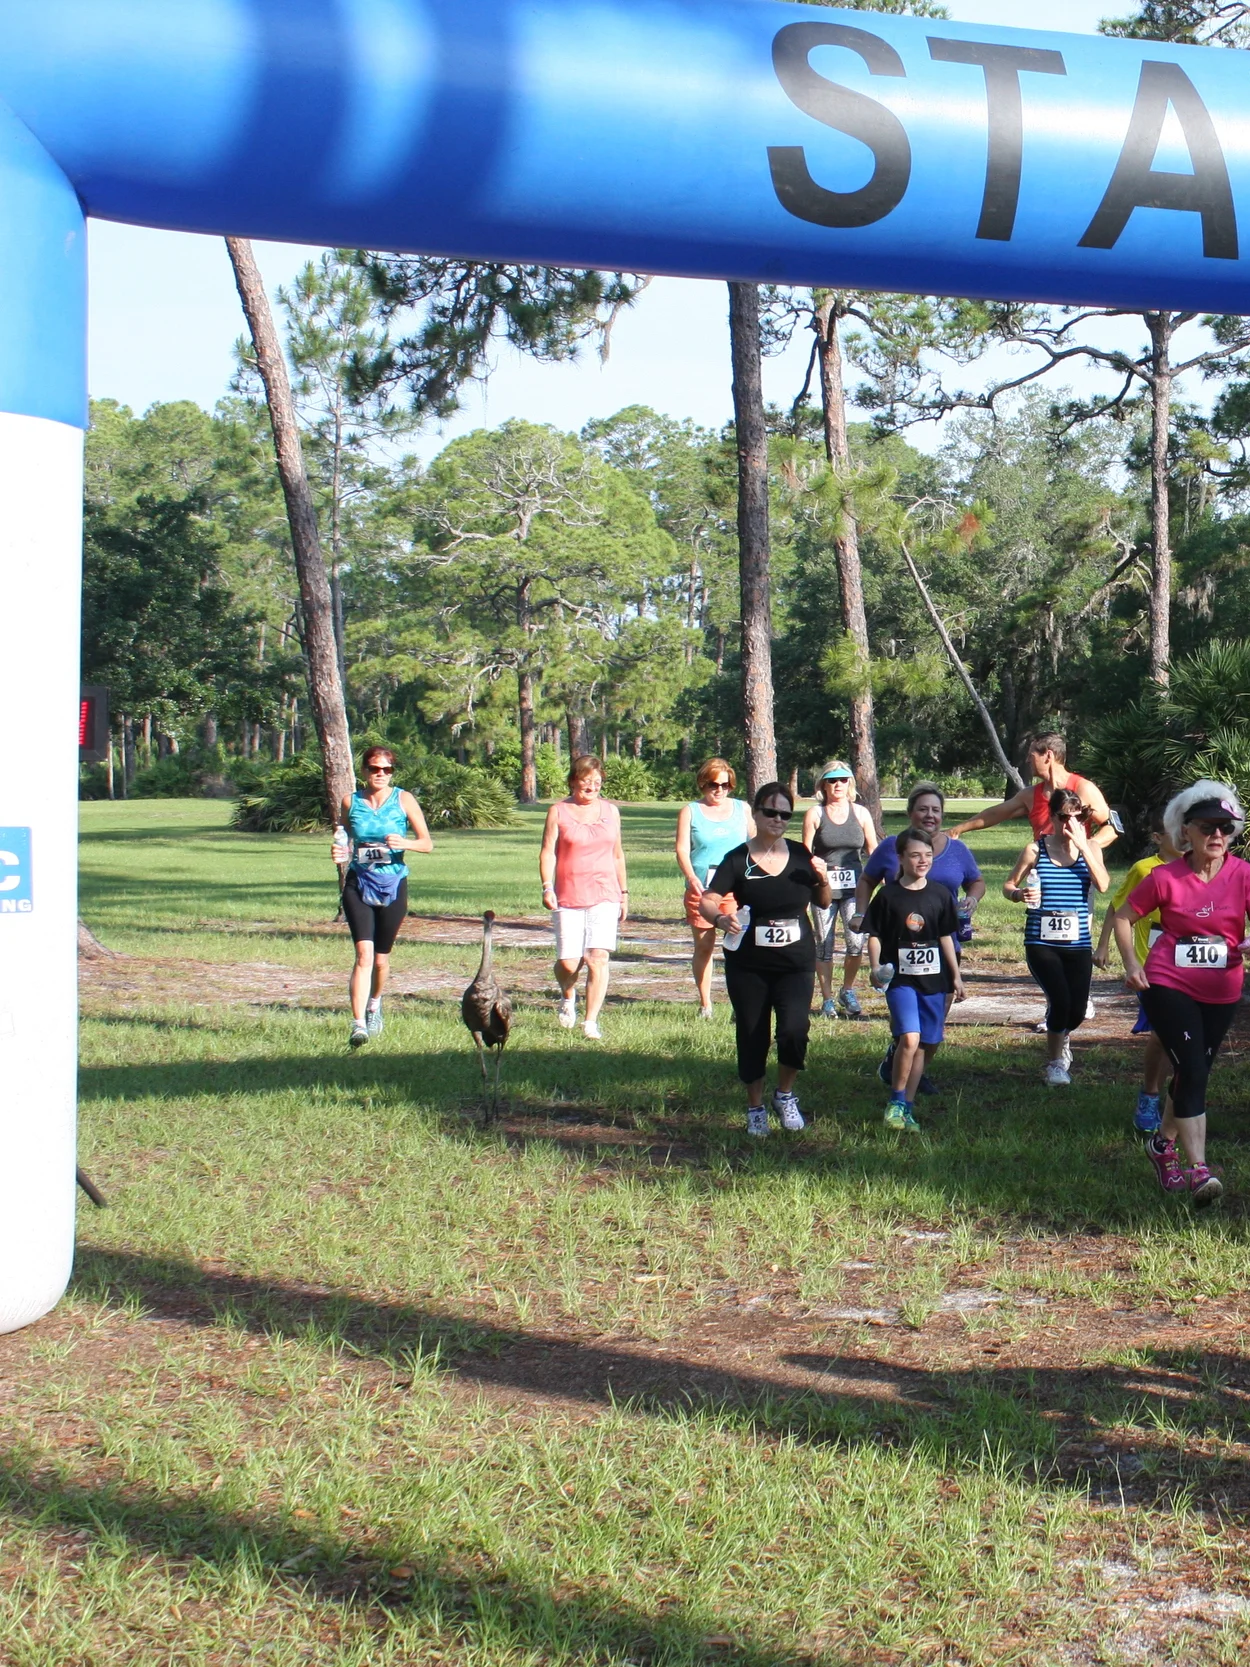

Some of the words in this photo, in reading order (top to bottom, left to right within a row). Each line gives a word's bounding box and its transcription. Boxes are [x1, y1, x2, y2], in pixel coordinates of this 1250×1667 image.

[364, 848, 383, 860] 411
[831, 871, 852, 882] 402
[1195, 900, 1214, 918] girl
[1048, 917, 1072, 931] 419
[764, 928, 792, 943] 421
[906, 949, 934, 965] 420
[1186, 945, 1219, 964] 410
